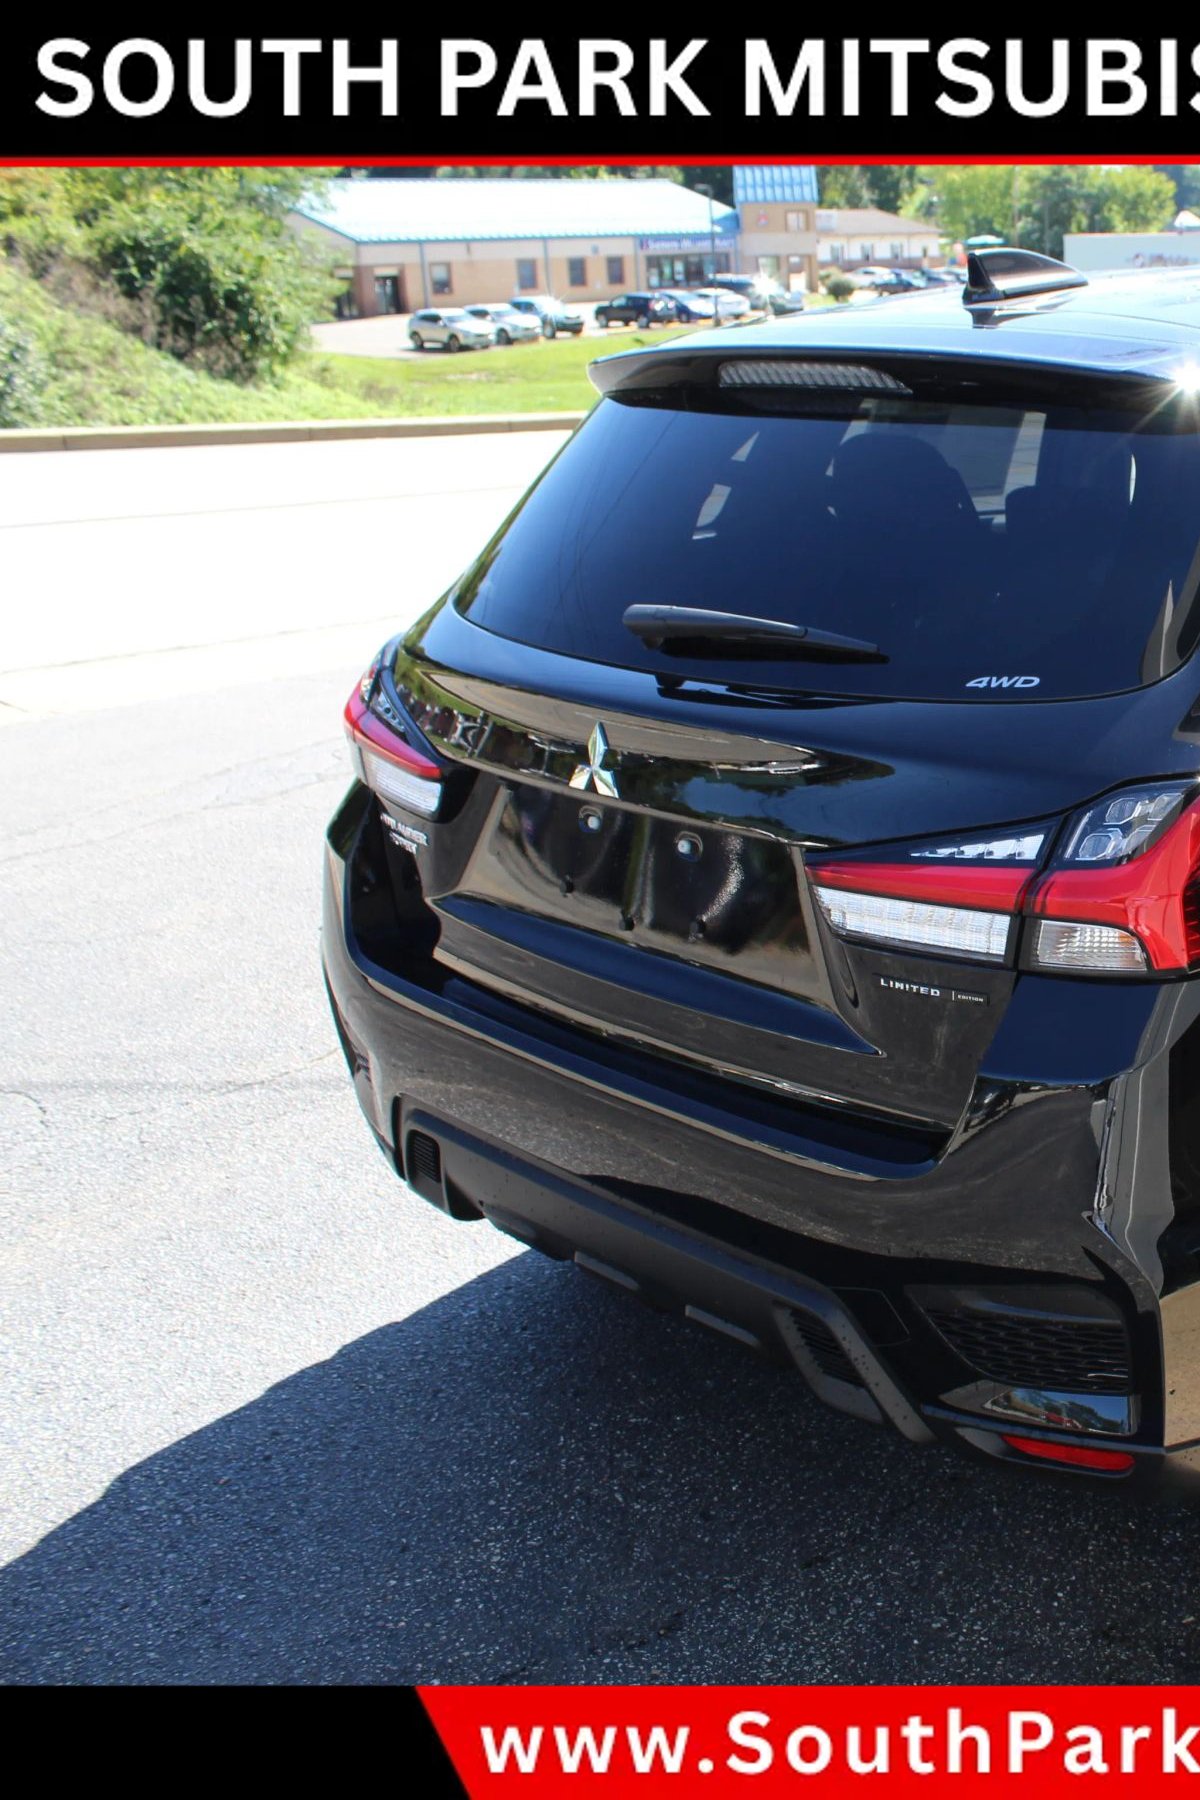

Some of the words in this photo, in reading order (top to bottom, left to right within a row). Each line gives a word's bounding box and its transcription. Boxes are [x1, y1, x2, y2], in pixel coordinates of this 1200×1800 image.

[965, 675, 1041, 689] 4WD
[880, 977, 941, 997] LIMITED
[957, 993, 985, 1003] EDITION
